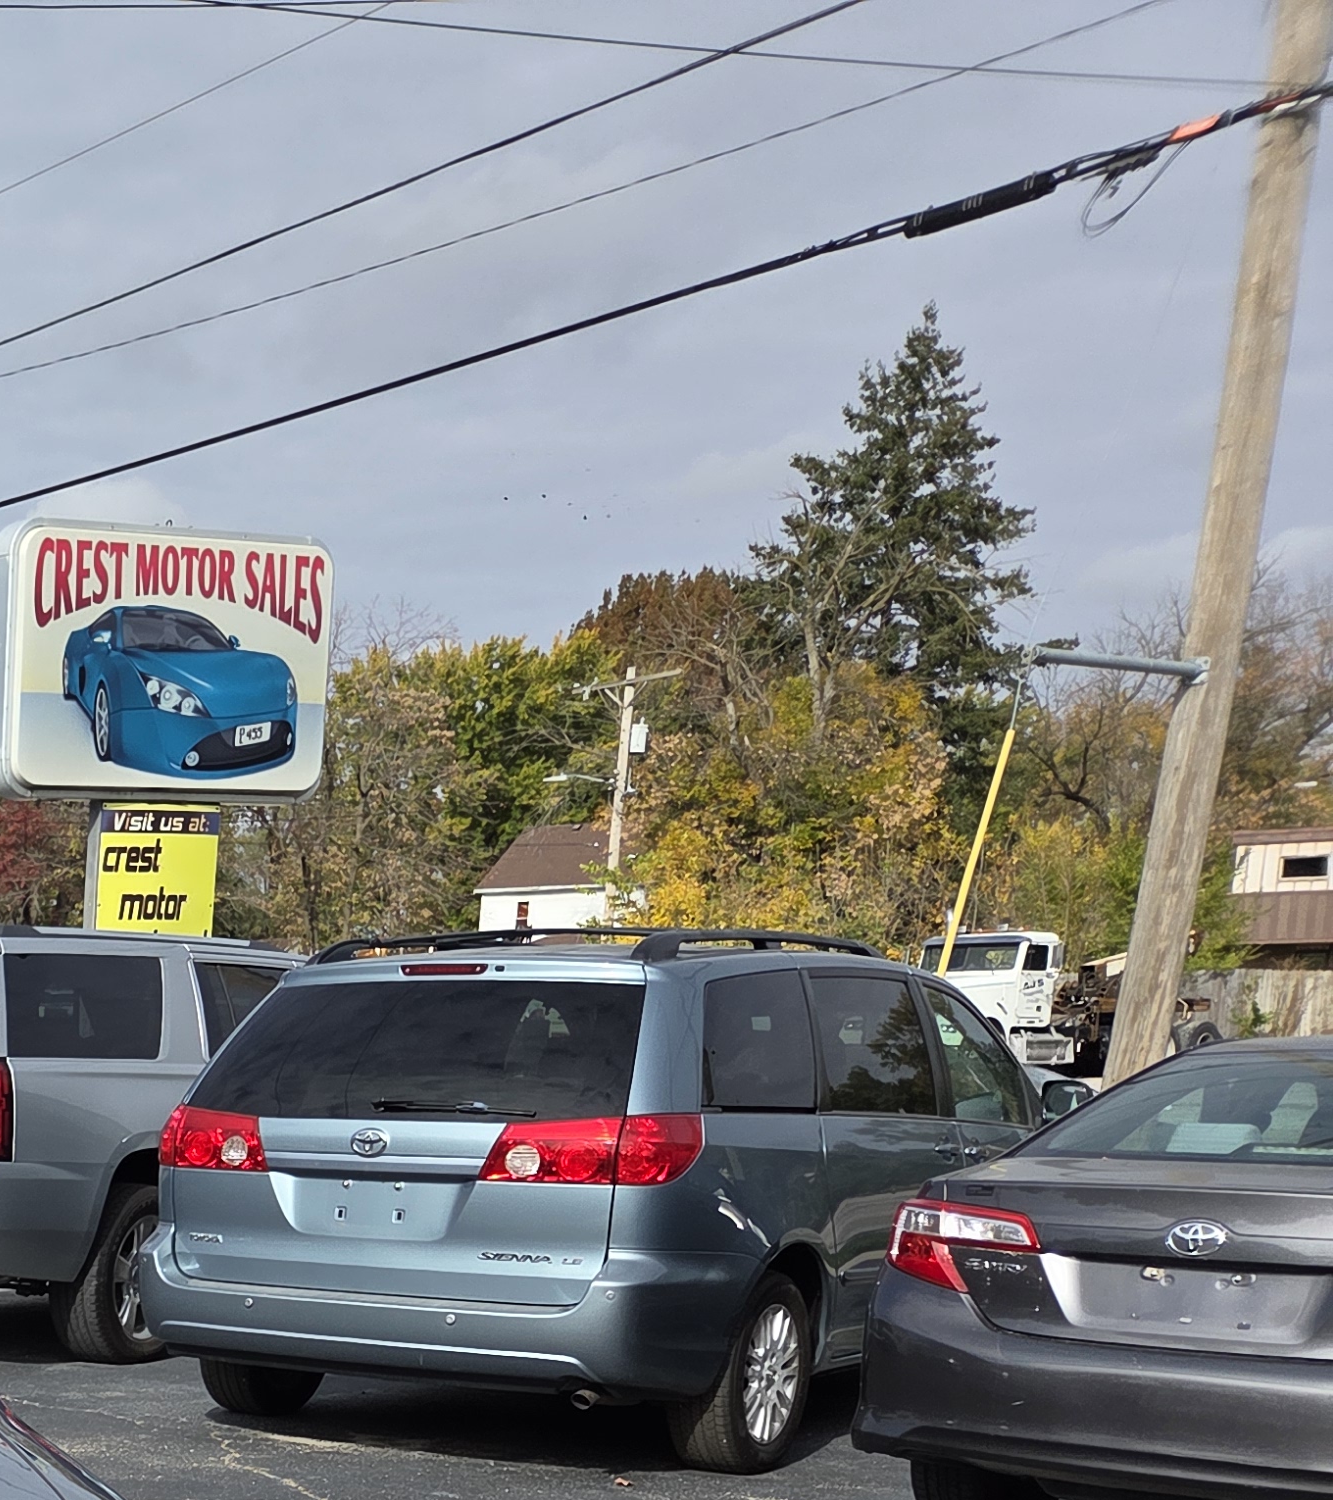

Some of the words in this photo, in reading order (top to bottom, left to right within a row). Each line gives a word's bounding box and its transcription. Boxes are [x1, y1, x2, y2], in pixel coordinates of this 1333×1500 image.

[33, 537, 129, 628] CREST
[135, 543, 237, 604] MOTOR
[243, 551, 325, 645] SALES
[113, 812, 155, 831] Visit
[159, 816, 185, 831] us
[188, 814, 210, 832] at:
[102, 838, 163, 873] crest
[118, 886, 188, 921] motor
